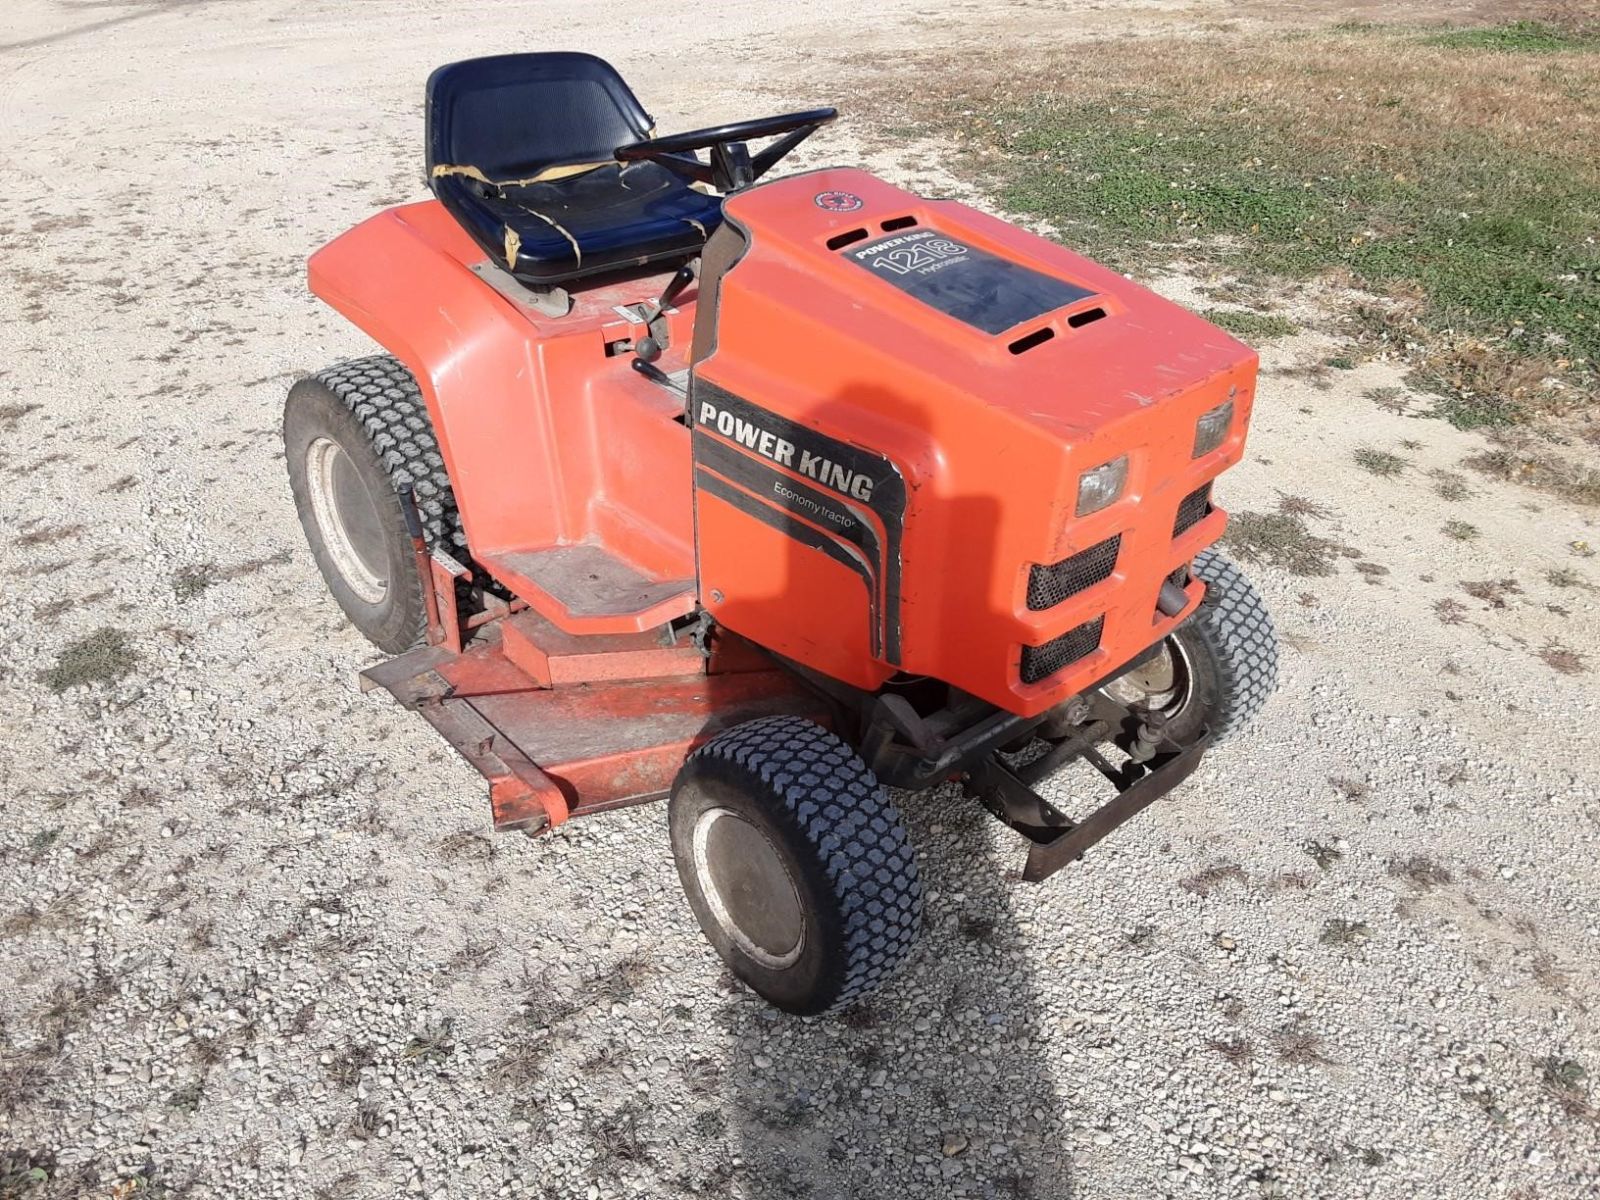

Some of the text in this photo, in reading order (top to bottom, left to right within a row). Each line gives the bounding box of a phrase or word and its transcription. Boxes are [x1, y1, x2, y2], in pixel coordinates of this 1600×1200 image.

[856, 231, 935, 259] POWER KING
[873, 239, 968, 275] 1218
[700, 401, 875, 502] POWER KING
[774, 482, 820, 515] Economy
